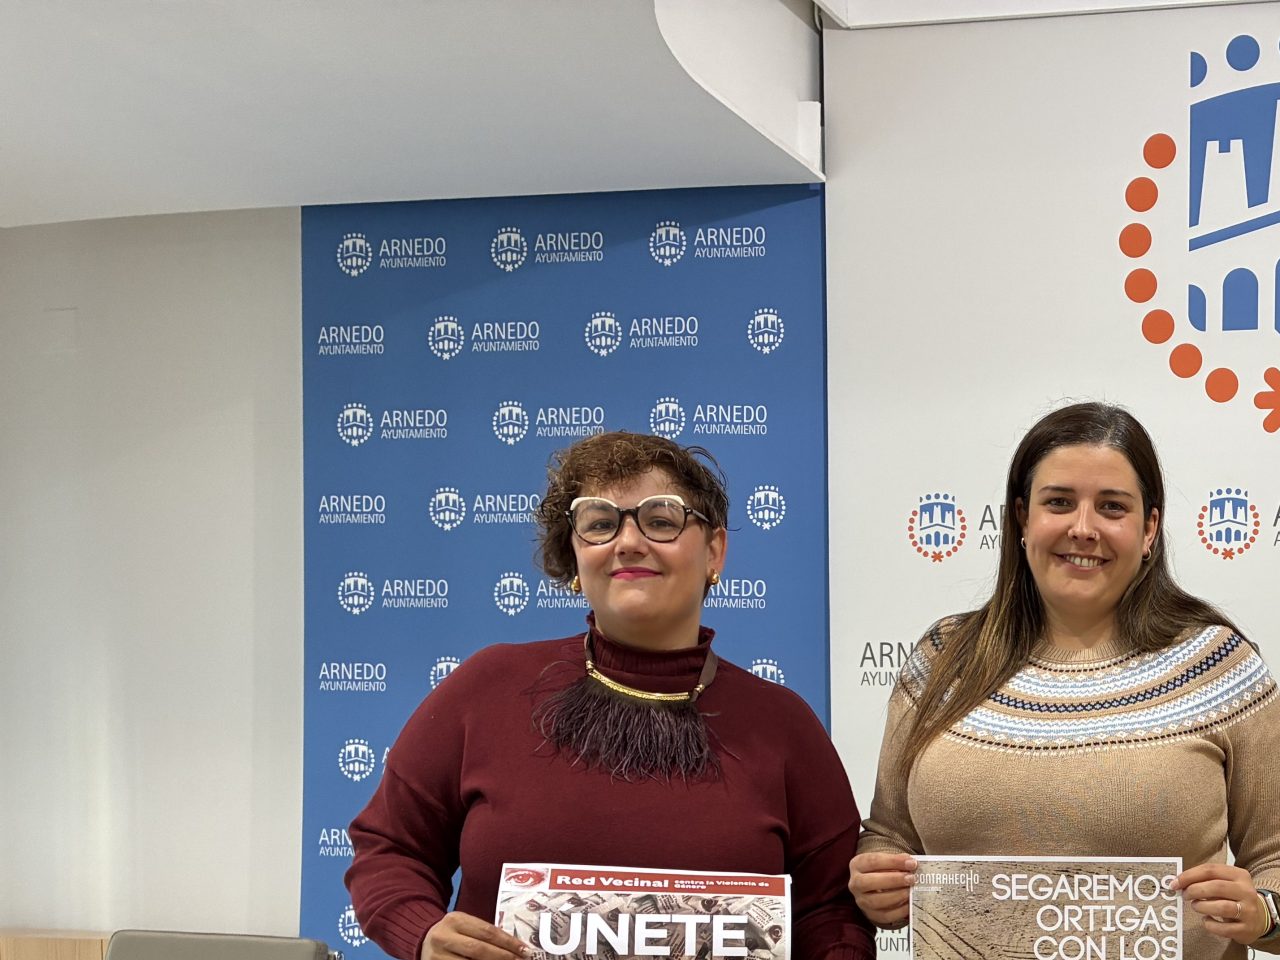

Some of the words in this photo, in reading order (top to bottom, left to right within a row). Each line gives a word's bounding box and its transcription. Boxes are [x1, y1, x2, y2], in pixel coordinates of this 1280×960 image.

[535, 232, 603, 250] ARNEDO
[694, 227, 765, 245] ARNEDO
[379, 238, 445, 256] ARNEDO
[695, 246, 765, 257] AYUNTAMIENTO
[380, 256, 446, 268] AYUNTAMIENTO
[536, 251, 603, 262] AYUNTAMIENTO
[318, 325, 384, 343] ARNEDO
[472, 322, 539, 339] ARNEDO
[630, 317, 698, 335] ARNEDO
[319, 344, 384, 354] AYUNTAMIENTO
[472, 340, 539, 351] AYUNTAMIENTO
[630, 336, 698, 348] AYUNTAMIENTO
[381, 410, 447, 427] ARNEDO
[536, 407, 604, 424] ARNEDO
[693, 405, 767, 422] ARNEDO
[381, 428, 447, 439] AYUNTAMIENTO
[694, 424, 767, 434] AYUNTAMIENTO
[319, 495, 385, 512] ARNEDO
[320, 514, 385, 523] AYUNTAMIENTO
[382, 580, 448, 596] ARNEDO
[383, 598, 448, 607] AYUNTAMIENTO
[319, 663, 386, 680] ARNEDO
[320, 681, 386, 691] AYUNTAMIENTO
[556, 875, 595, 886] Red
[599, 876, 668, 888] Vecinal
[991, 874, 1178, 900] SEGAREMOS
[1036, 905, 1178, 931] ORTIGAS
[538, 903, 748, 956] ÚNETE
